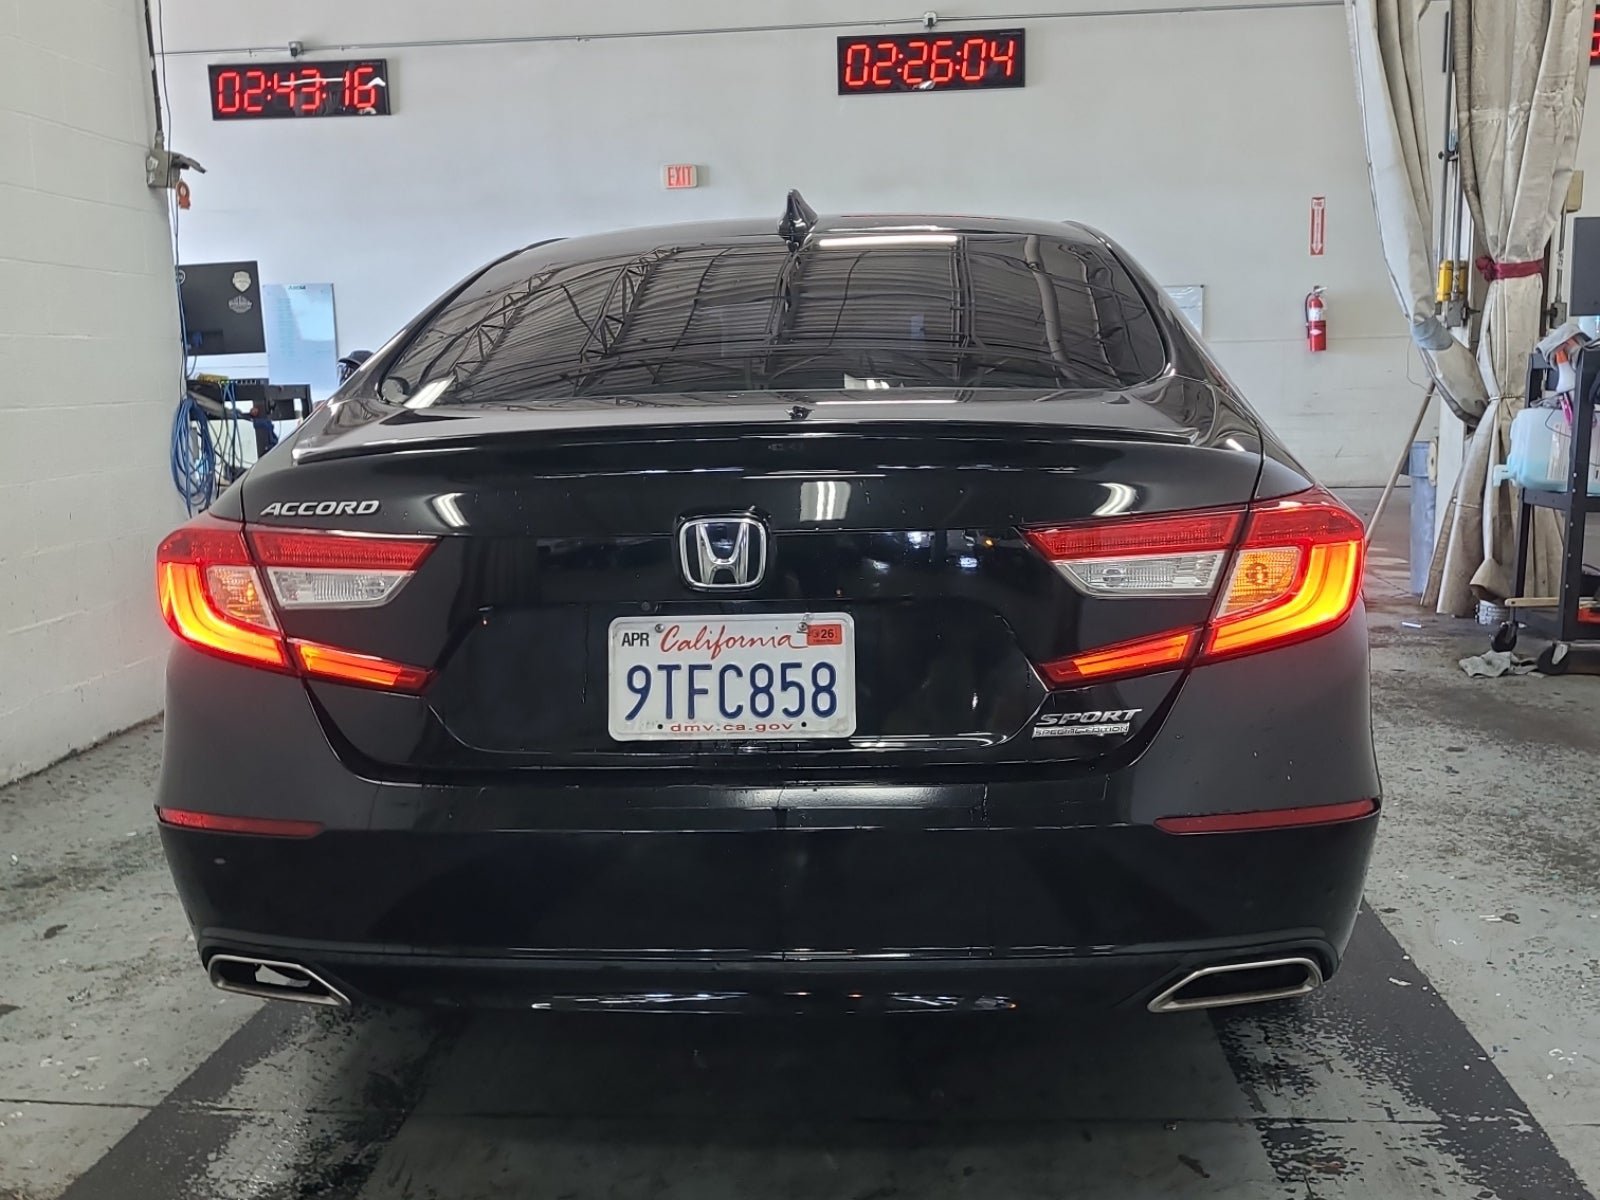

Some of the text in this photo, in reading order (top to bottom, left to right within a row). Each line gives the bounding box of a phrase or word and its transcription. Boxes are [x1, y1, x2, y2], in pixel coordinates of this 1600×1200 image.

[845, 38, 1015, 86] 02:26:04
[216, 66, 377, 112] 02:43:16
[667, 165, 692, 187] EXIT
[260, 500, 380, 516] ACCORD
[621, 624, 808, 659] APR California
[820, 628, 835, 639] 26
[625, 661, 838, 721] 9TFC858
[670, 722, 794, 732] dmv.ca.gov
[1036, 708, 1142, 726] SPORT
